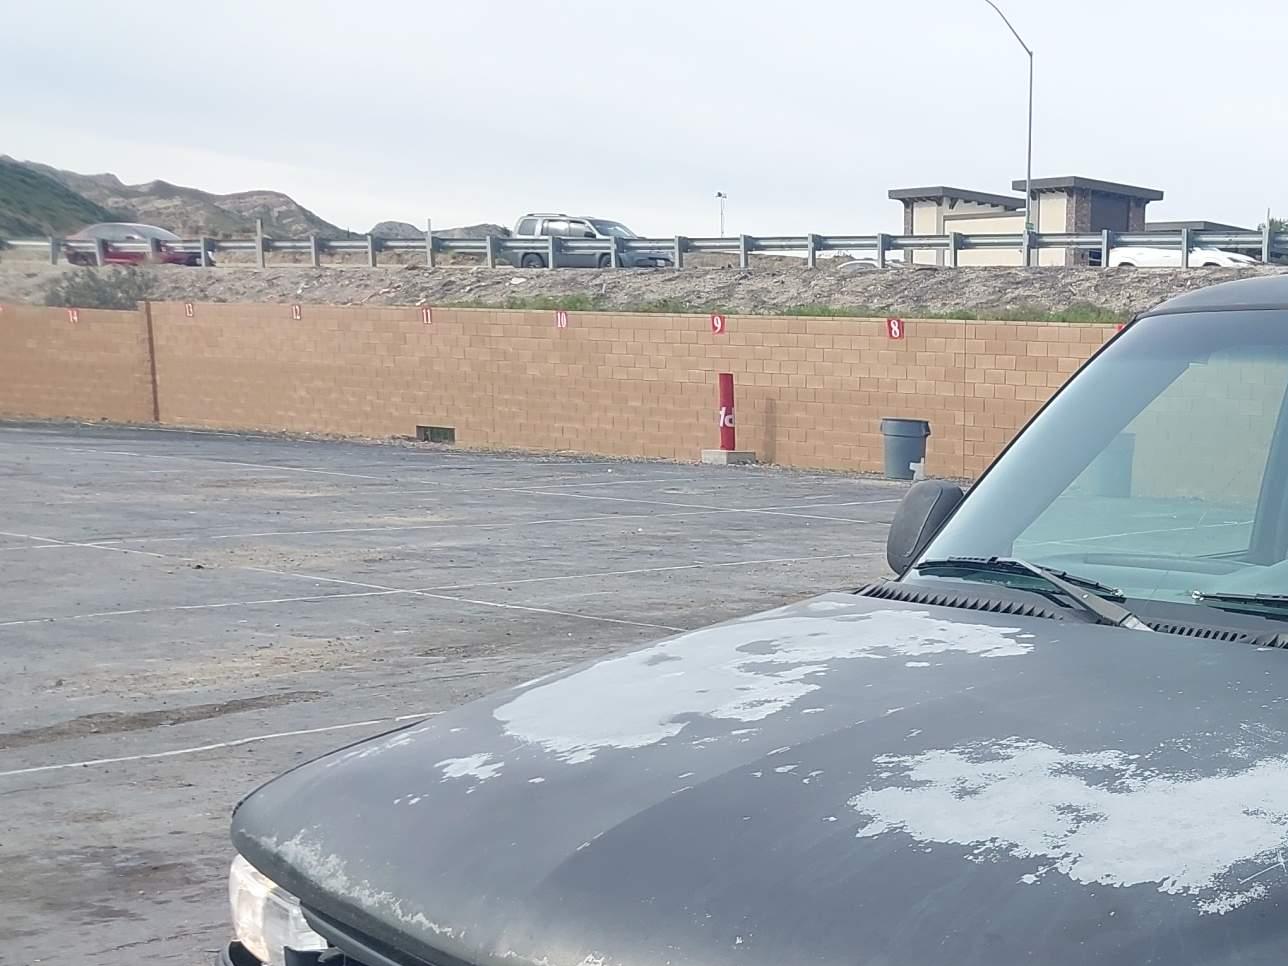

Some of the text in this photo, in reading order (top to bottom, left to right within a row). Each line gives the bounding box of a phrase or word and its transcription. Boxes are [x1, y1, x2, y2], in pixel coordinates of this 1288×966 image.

[292, 305, 301, 319] 12
[422, 309, 432, 324] 11
[557, 312, 566, 328] 10
[713, 316, 721, 332] 9
[891, 320, 900, 337] 8
